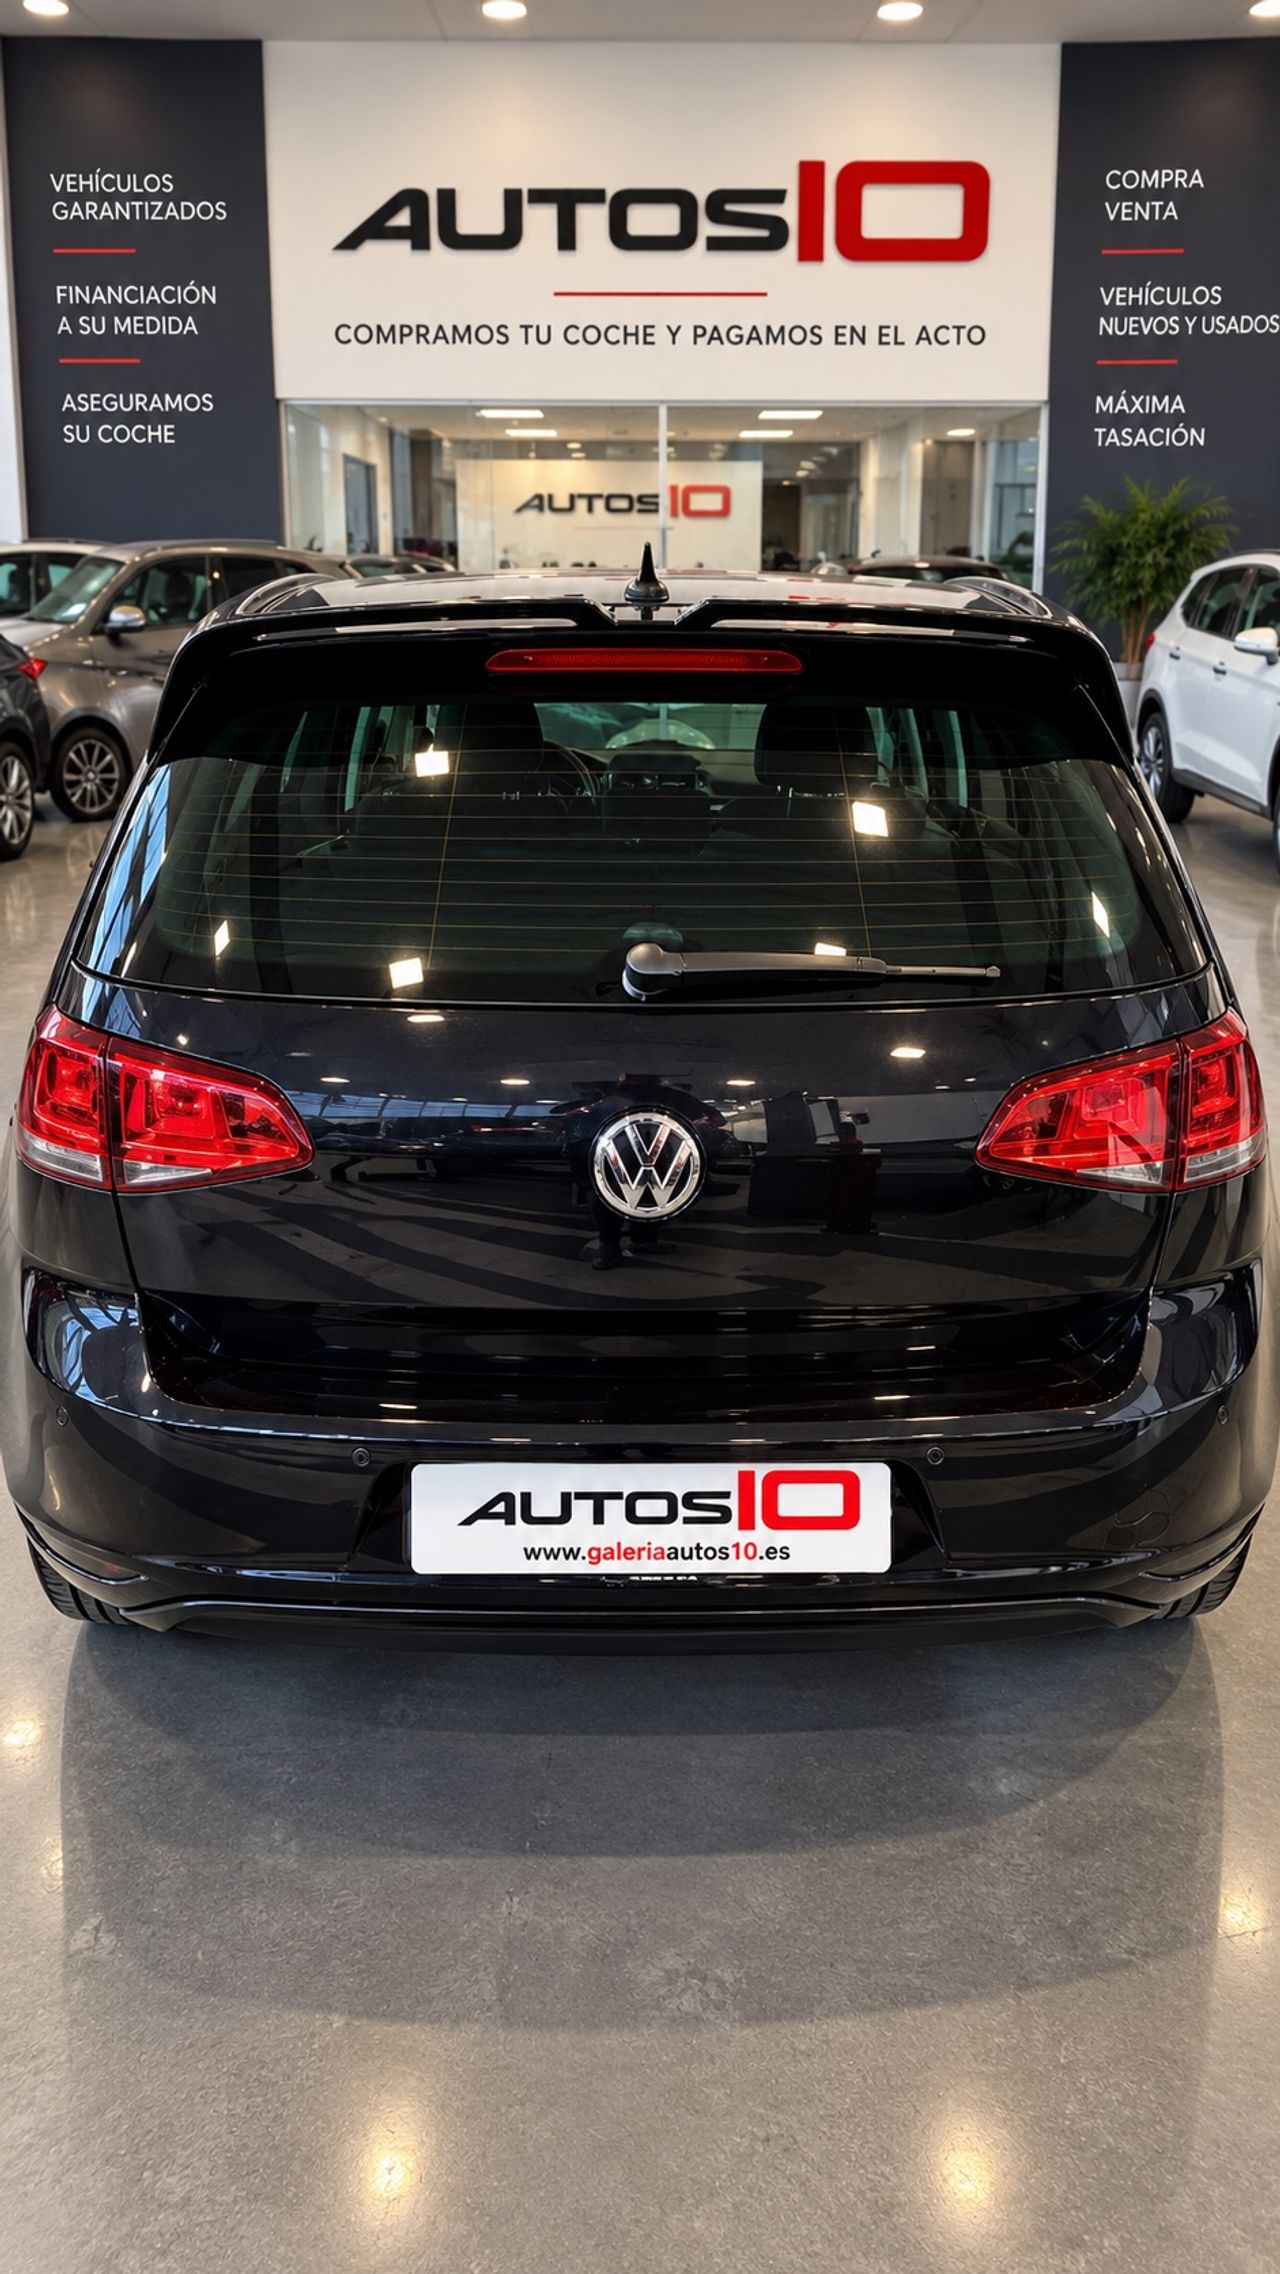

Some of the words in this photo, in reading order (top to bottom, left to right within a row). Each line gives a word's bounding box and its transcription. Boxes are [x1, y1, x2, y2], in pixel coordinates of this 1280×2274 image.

[50, 168, 173, 192] VEHÍCULOS
[1106, 169, 1204, 189] COMPRA
[52, 201, 227, 220] GARANTIZADOS
[1105, 201, 1178, 221] VENTA
[56, 280, 216, 304] FINANCIACIÓN
[1100, 281, 1221, 305] VEHÍCULOS
[58, 316, 72, 334] A
[79, 316, 105, 334] SU
[114, 316, 198, 334] MEDIDA
[335, 324, 509, 345] COMPRAMOS
[520, 325, 551, 345] TU
[564, 324, 655, 345] COCHE
[666, 325, 681, 345] Y
[693, 325, 822, 345] PAGAMOS
[835, 325, 866, 345] EN
[878, 325, 905, 345] EL
[916, 325, 985, 345] ACTO
[1099, 316, 1179, 335] NUEVOS
[1185, 316, 1197, 334] Y
[1202, 314, 1280, 334] USADOS
[62, 393, 213, 411] ASEGURAMOS
[1096, 391, 1185, 413] MÁXIMA
[63, 425, 89, 443] SU
[98, 425, 175, 443] COCHE
[1094, 423, 1205, 446] TASACIÓN
[523, 1542, 790, 1565] www.galeriaautos10.es
